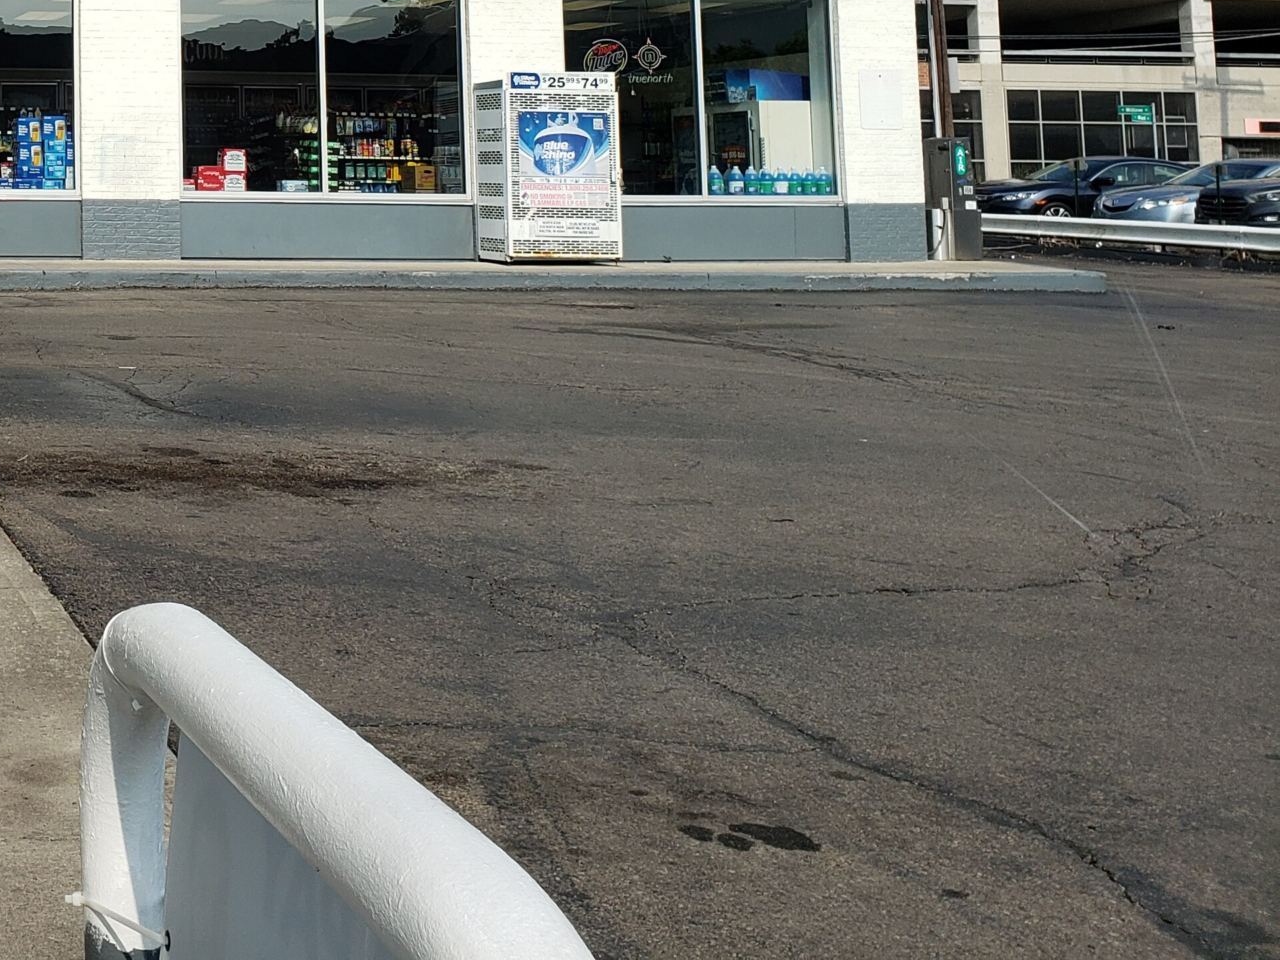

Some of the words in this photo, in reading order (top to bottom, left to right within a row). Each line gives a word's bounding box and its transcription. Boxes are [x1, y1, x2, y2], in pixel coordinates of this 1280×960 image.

[628, 73, 673, 83] truenorth
[543, 141, 569, 150] Blue
[540, 150, 576, 160] Rhino
[956, 149, 965, 172] AIR
